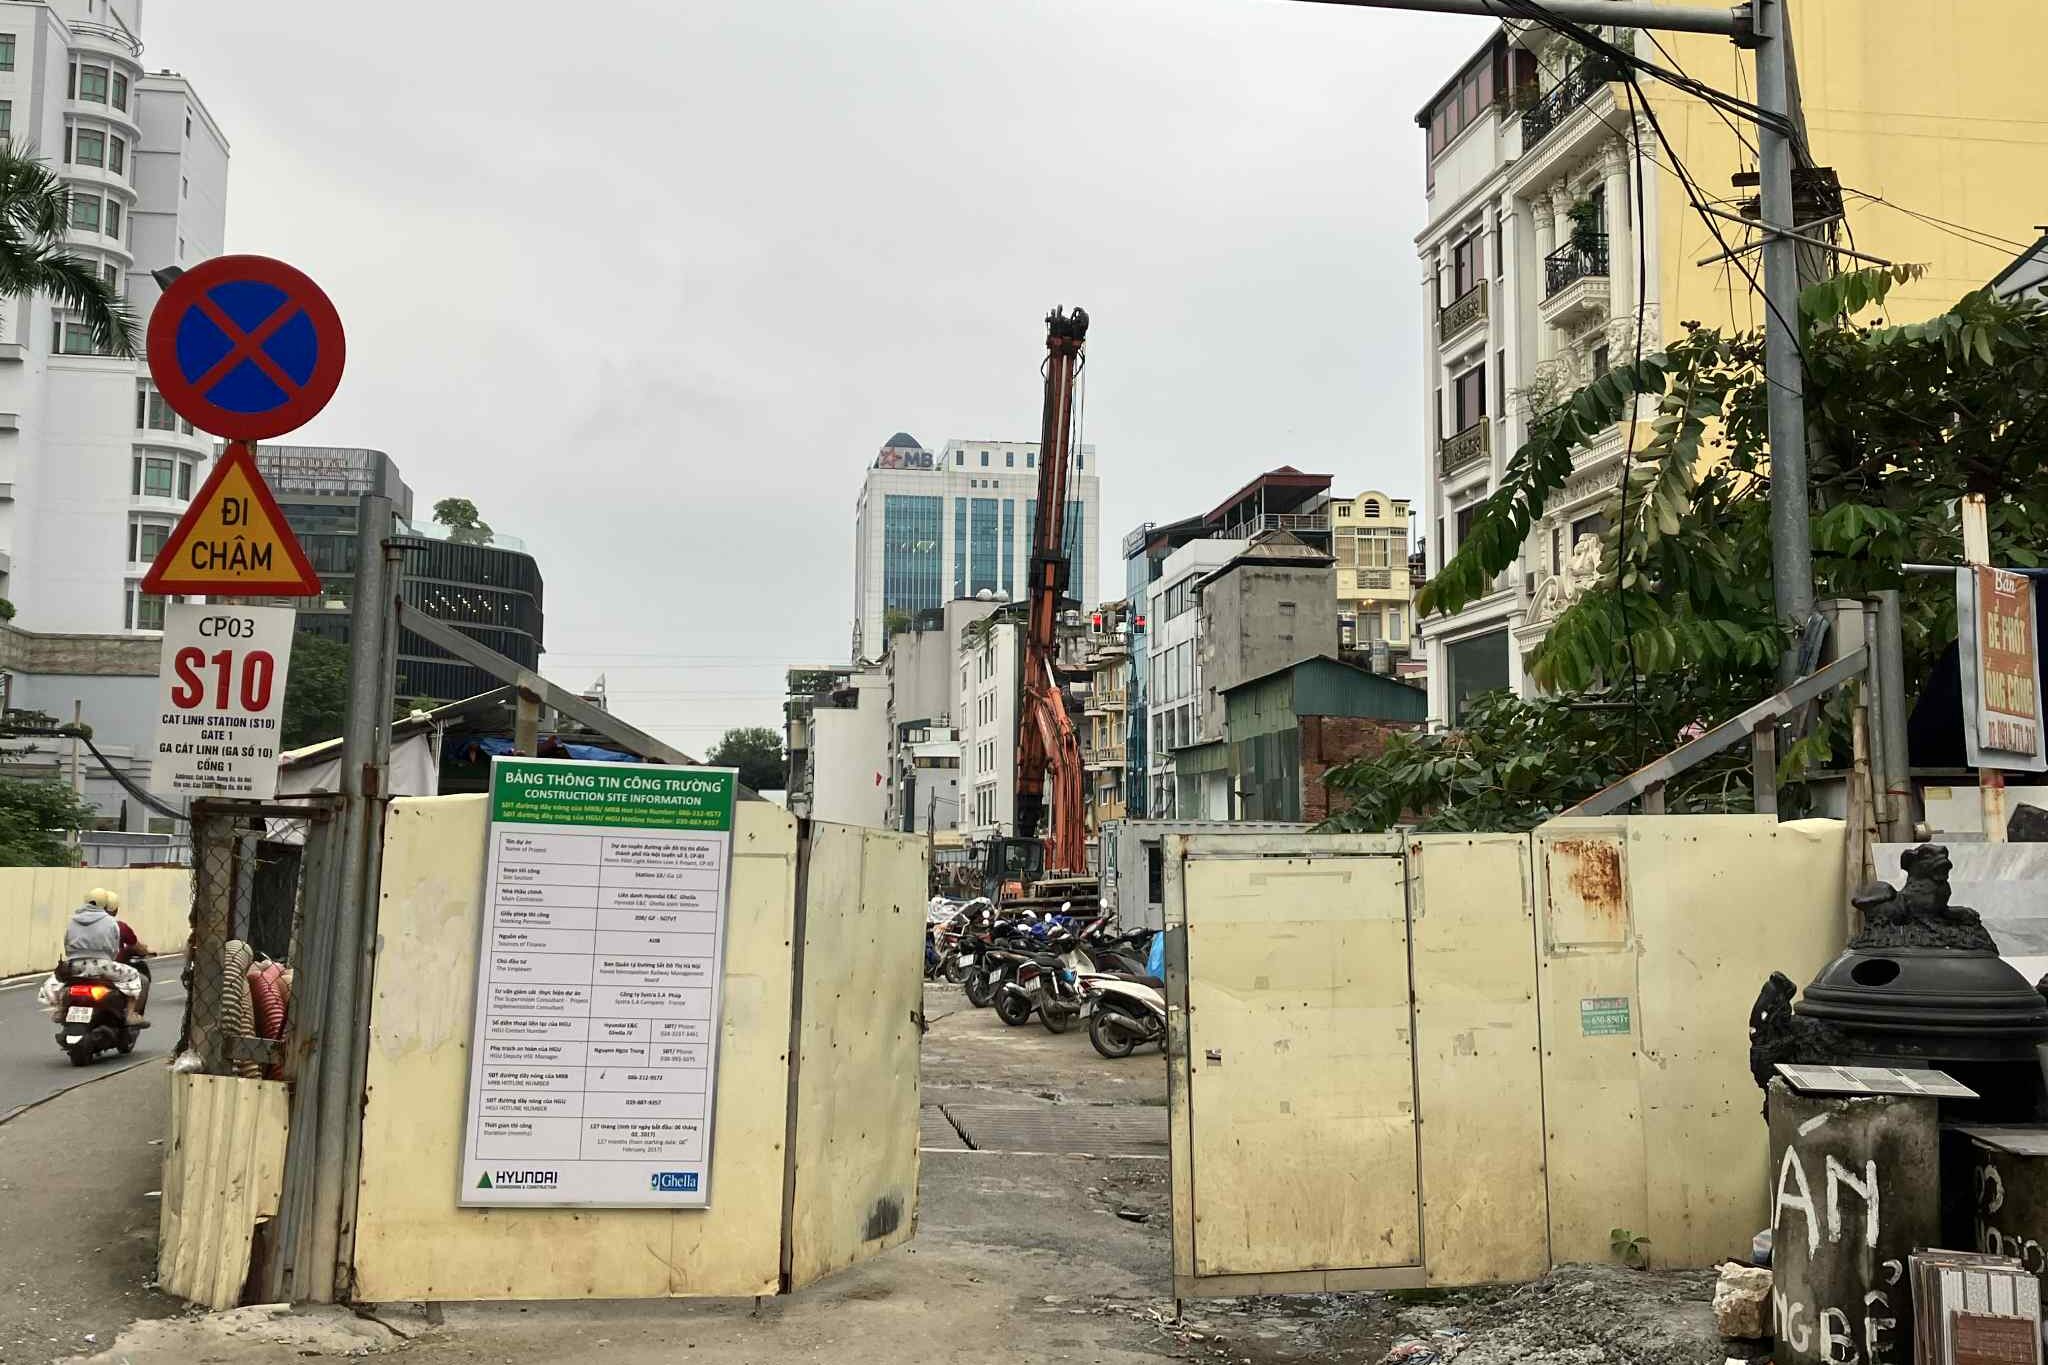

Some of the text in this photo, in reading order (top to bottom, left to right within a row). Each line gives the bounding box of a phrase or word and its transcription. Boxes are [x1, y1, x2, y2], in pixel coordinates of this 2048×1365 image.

[221, 497, 248, 526] ĐI
[191, 534, 272, 576] CHẬM
[199, 617, 254, 638] CP03
[171, 646, 274, 712] S10
[162, 714, 275, 729] CAT LINH STATION (S10)
[201, 730, 233, 741] GATE 1
[159, 741, 273, 759] GA CÁT LINH (GA SỐ 10)
[228, 762, 232, 772] 1
[505, 768, 721, 793] BẢNG THÔNG TIN CÔNG TRƯỜNG
[524, 789, 702, 806] CONSTRUCTION SITE INFORMATION
[496, 1171, 558, 1184] HYUNDAI
[661, 1174, 697, 1188] Ghella
